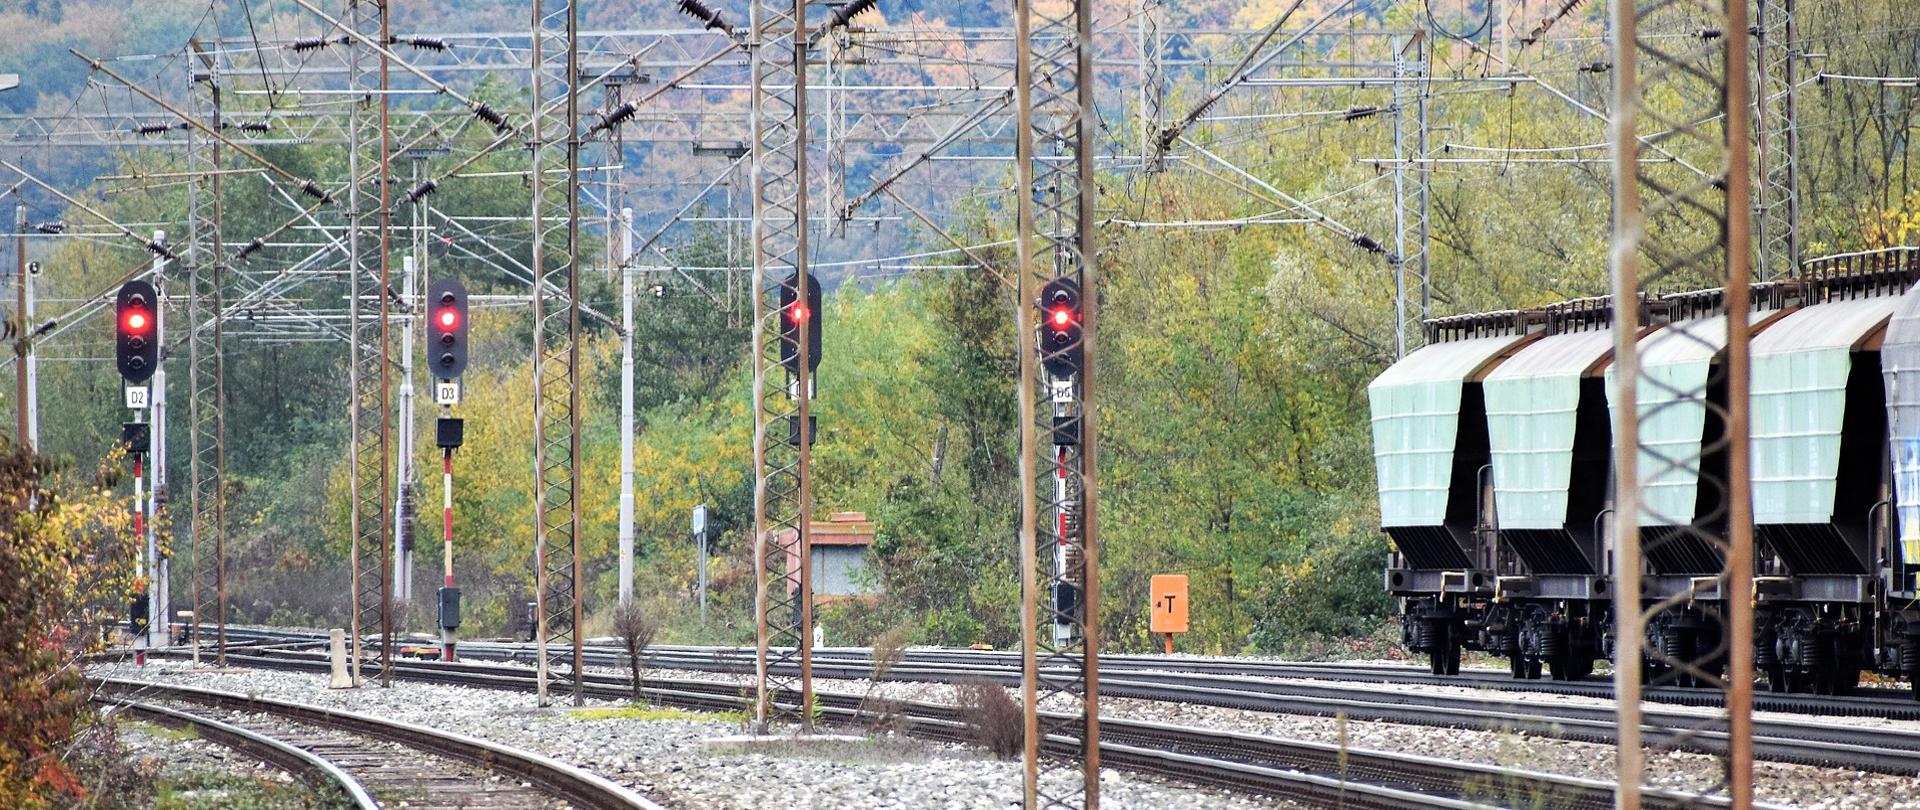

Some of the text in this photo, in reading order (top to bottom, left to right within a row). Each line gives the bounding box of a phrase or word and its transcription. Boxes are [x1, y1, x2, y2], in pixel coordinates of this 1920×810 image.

[131, 391, 143, 404] D2
[442, 387, 454, 400] D3
[1164, 595, 1176, 613] T
